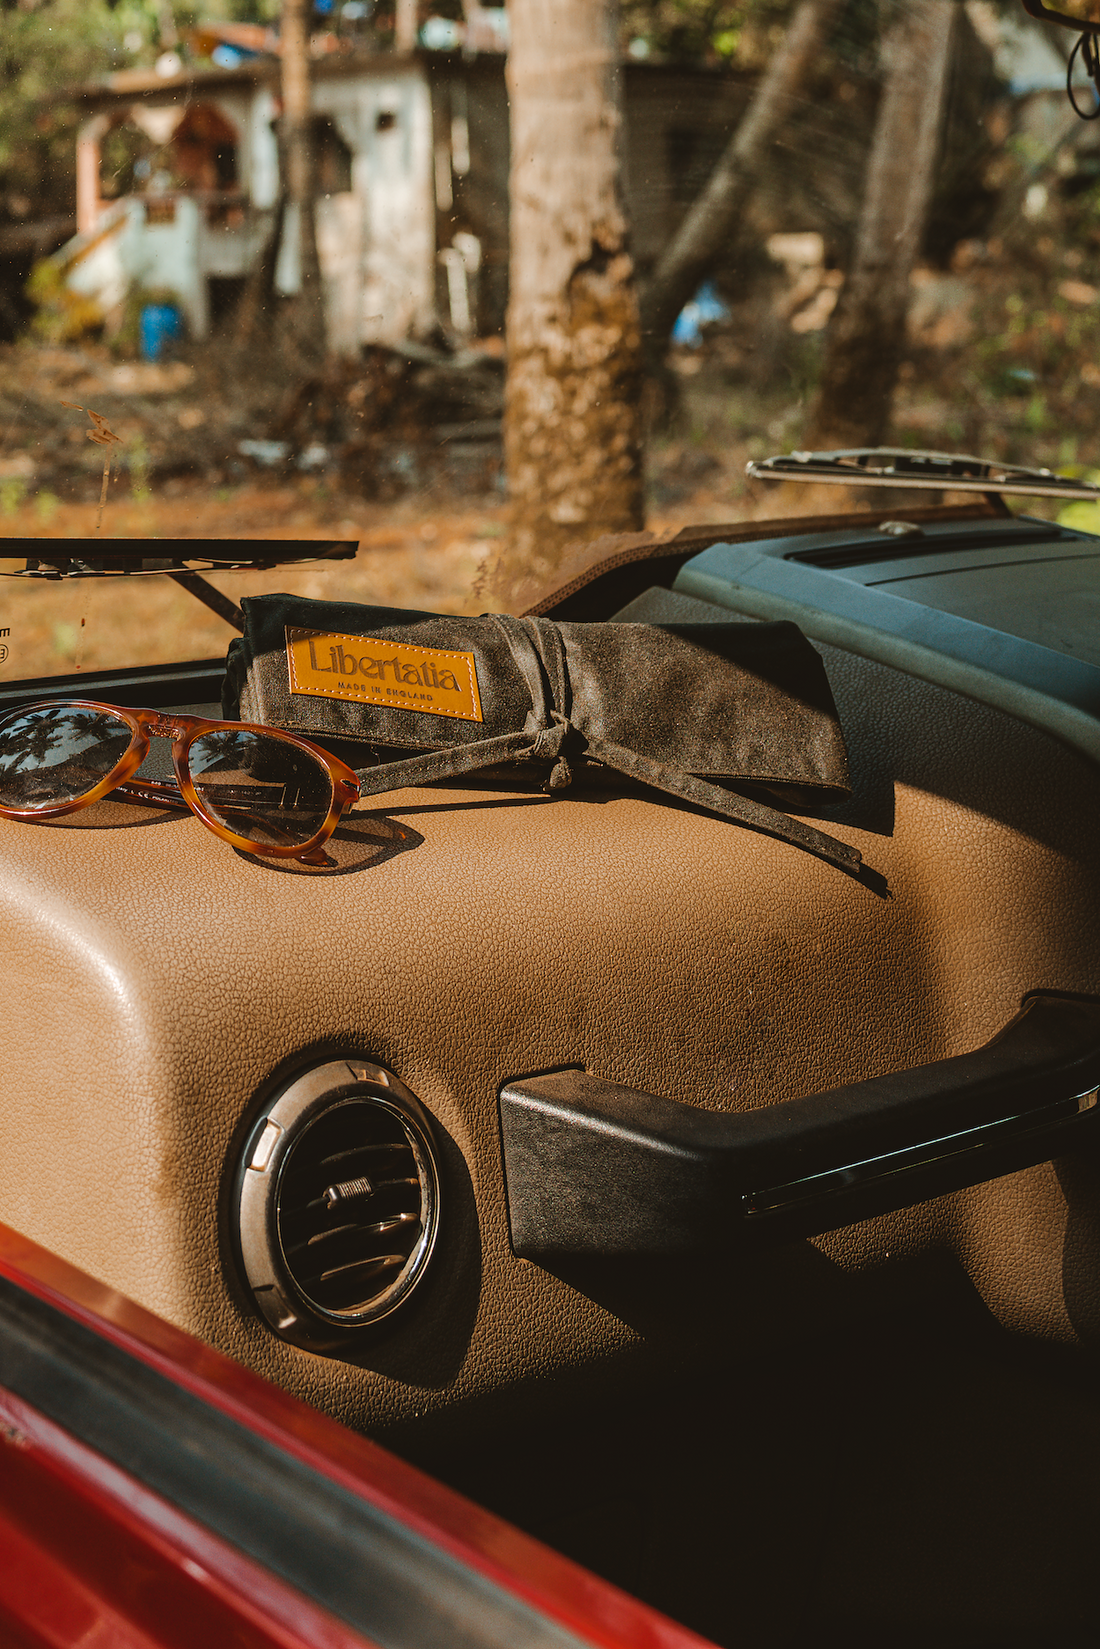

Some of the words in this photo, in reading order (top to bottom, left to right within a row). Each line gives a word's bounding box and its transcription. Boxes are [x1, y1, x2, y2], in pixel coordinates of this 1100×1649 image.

[337, 681, 366, 693] MADE
[371, 685, 382, 694] IN
[386, 688, 434, 702] ENGLAND
